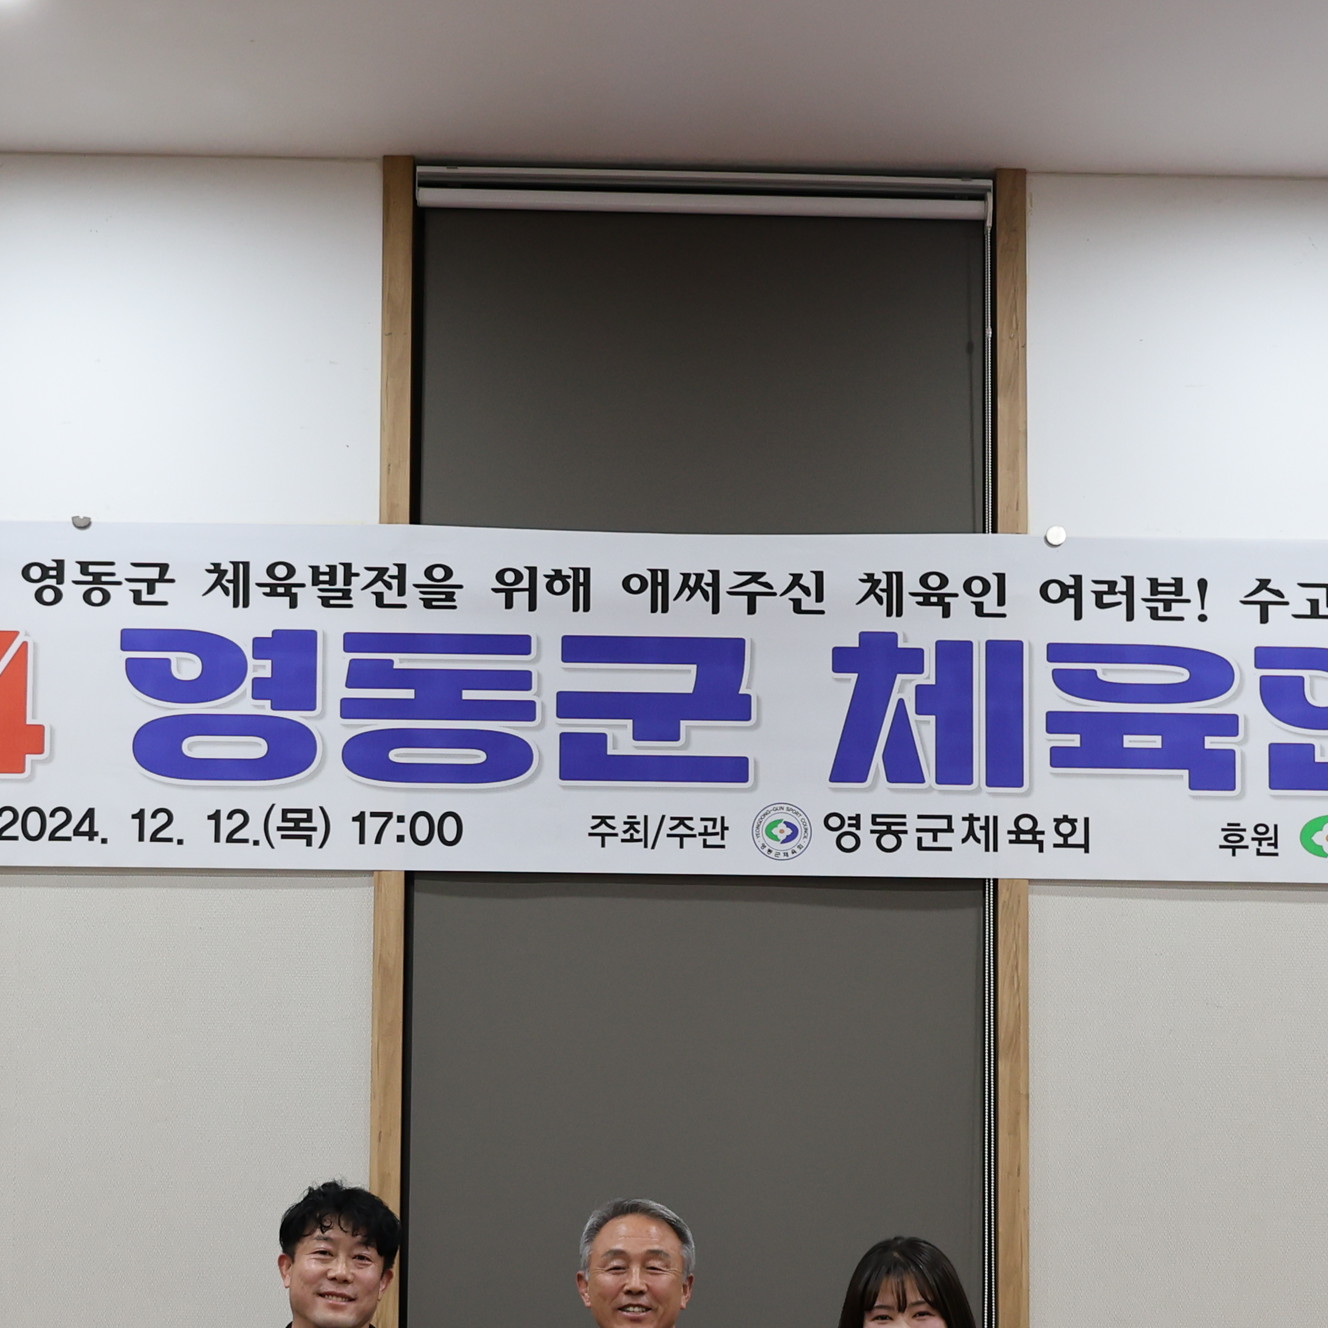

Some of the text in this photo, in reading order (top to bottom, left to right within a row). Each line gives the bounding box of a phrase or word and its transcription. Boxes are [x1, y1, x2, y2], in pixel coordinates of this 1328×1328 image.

[22, 559, 176, 607] 영동군
[202, 560, 464, 610] 체육발전을
[490, 565, 591, 613] 위해
[621, 568, 826, 616] 애써주신
[855, 570, 1007, 619] 체육인
[1039, 574, 1208, 623] 여러분!
[120, 628, 753, 784] 영동군
[131, 807, 184, 846] 12.
[207, 803, 331, 850] 12.(목)
[351, 810, 464, 847] 17:00
[587, 814, 730, 850] 주최/주관
[823, 811, 1090, 854] 영동군체육회
[1218, 822, 1279, 857] 후원
